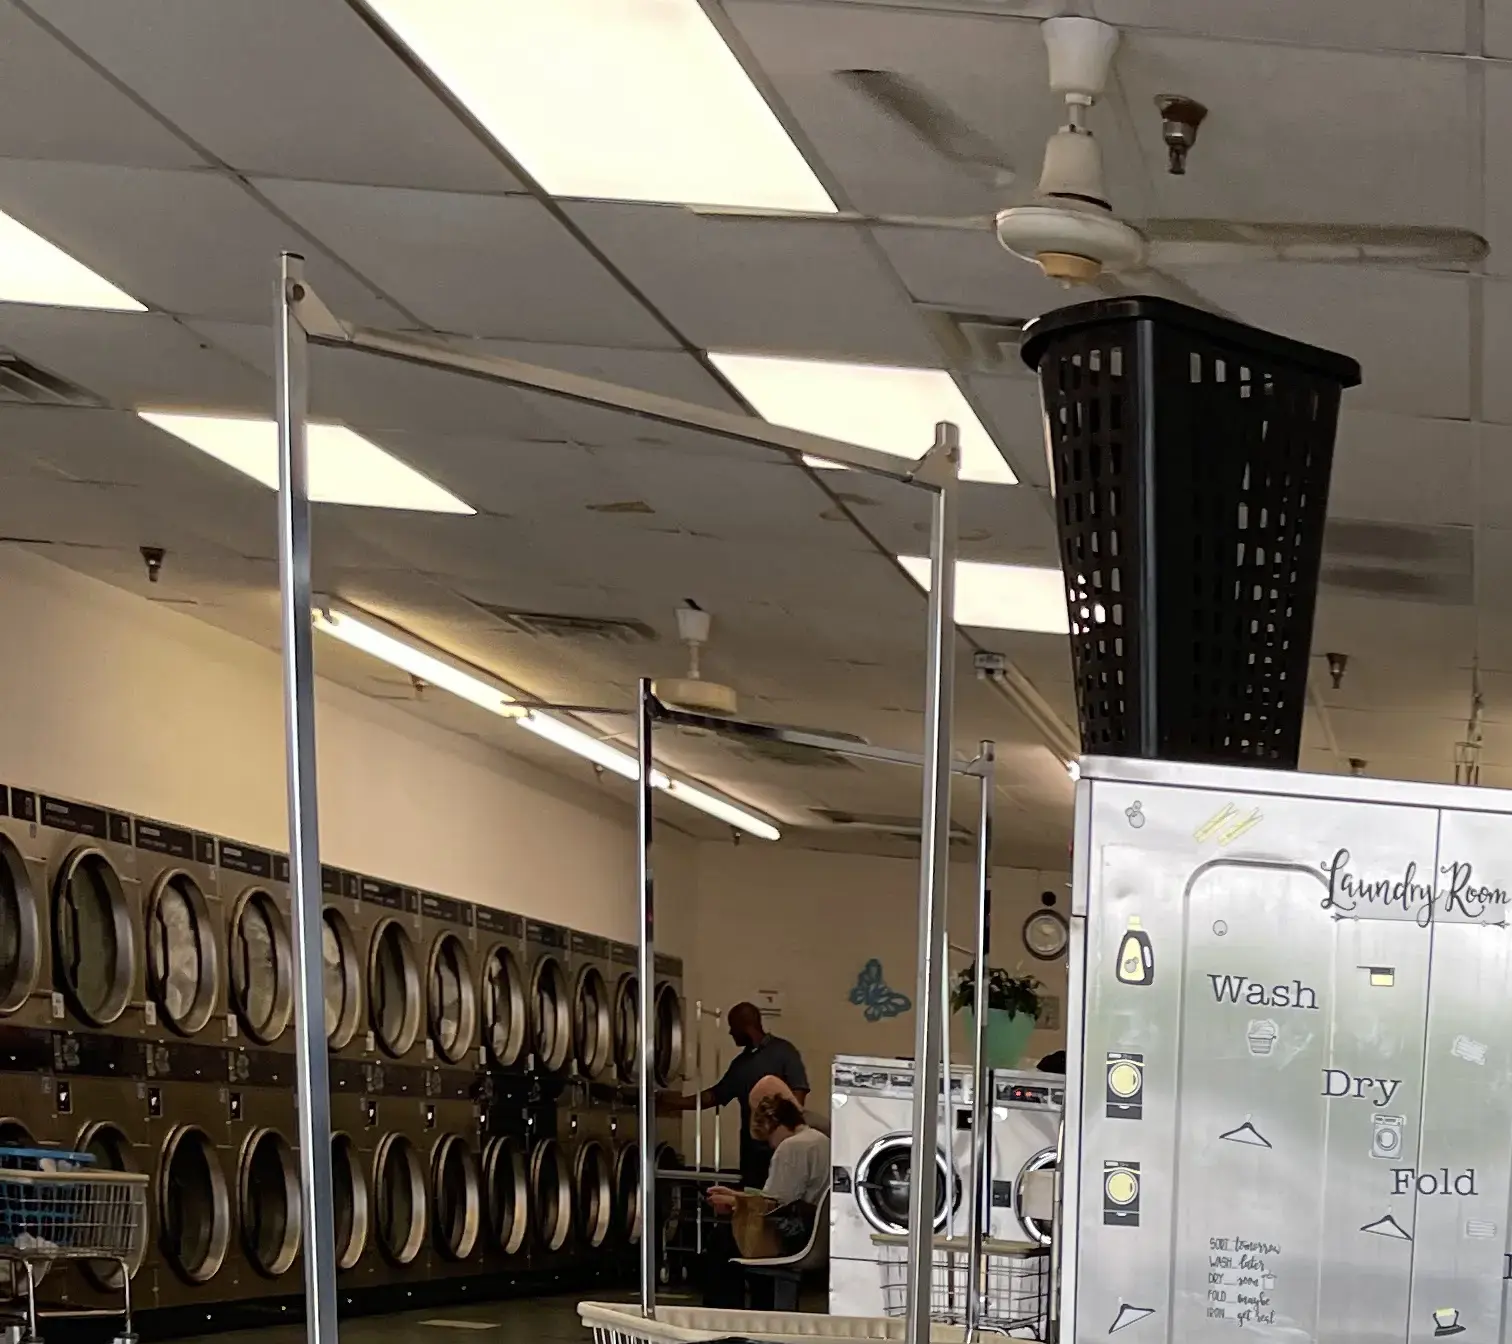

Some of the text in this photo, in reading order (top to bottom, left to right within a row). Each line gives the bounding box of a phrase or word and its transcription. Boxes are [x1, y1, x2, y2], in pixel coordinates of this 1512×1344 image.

[1320, 848, 1511, 928] Laundry Room
[1207, 972, 1319, 1010] Wash
[1322, 1068, 1401, 1105] Dry
[1390, 1168, 1478, 1196] Fold
[1208, 1255, 1232, 1269] WASH
[1207, 1289, 1226, 1302] FOLD
